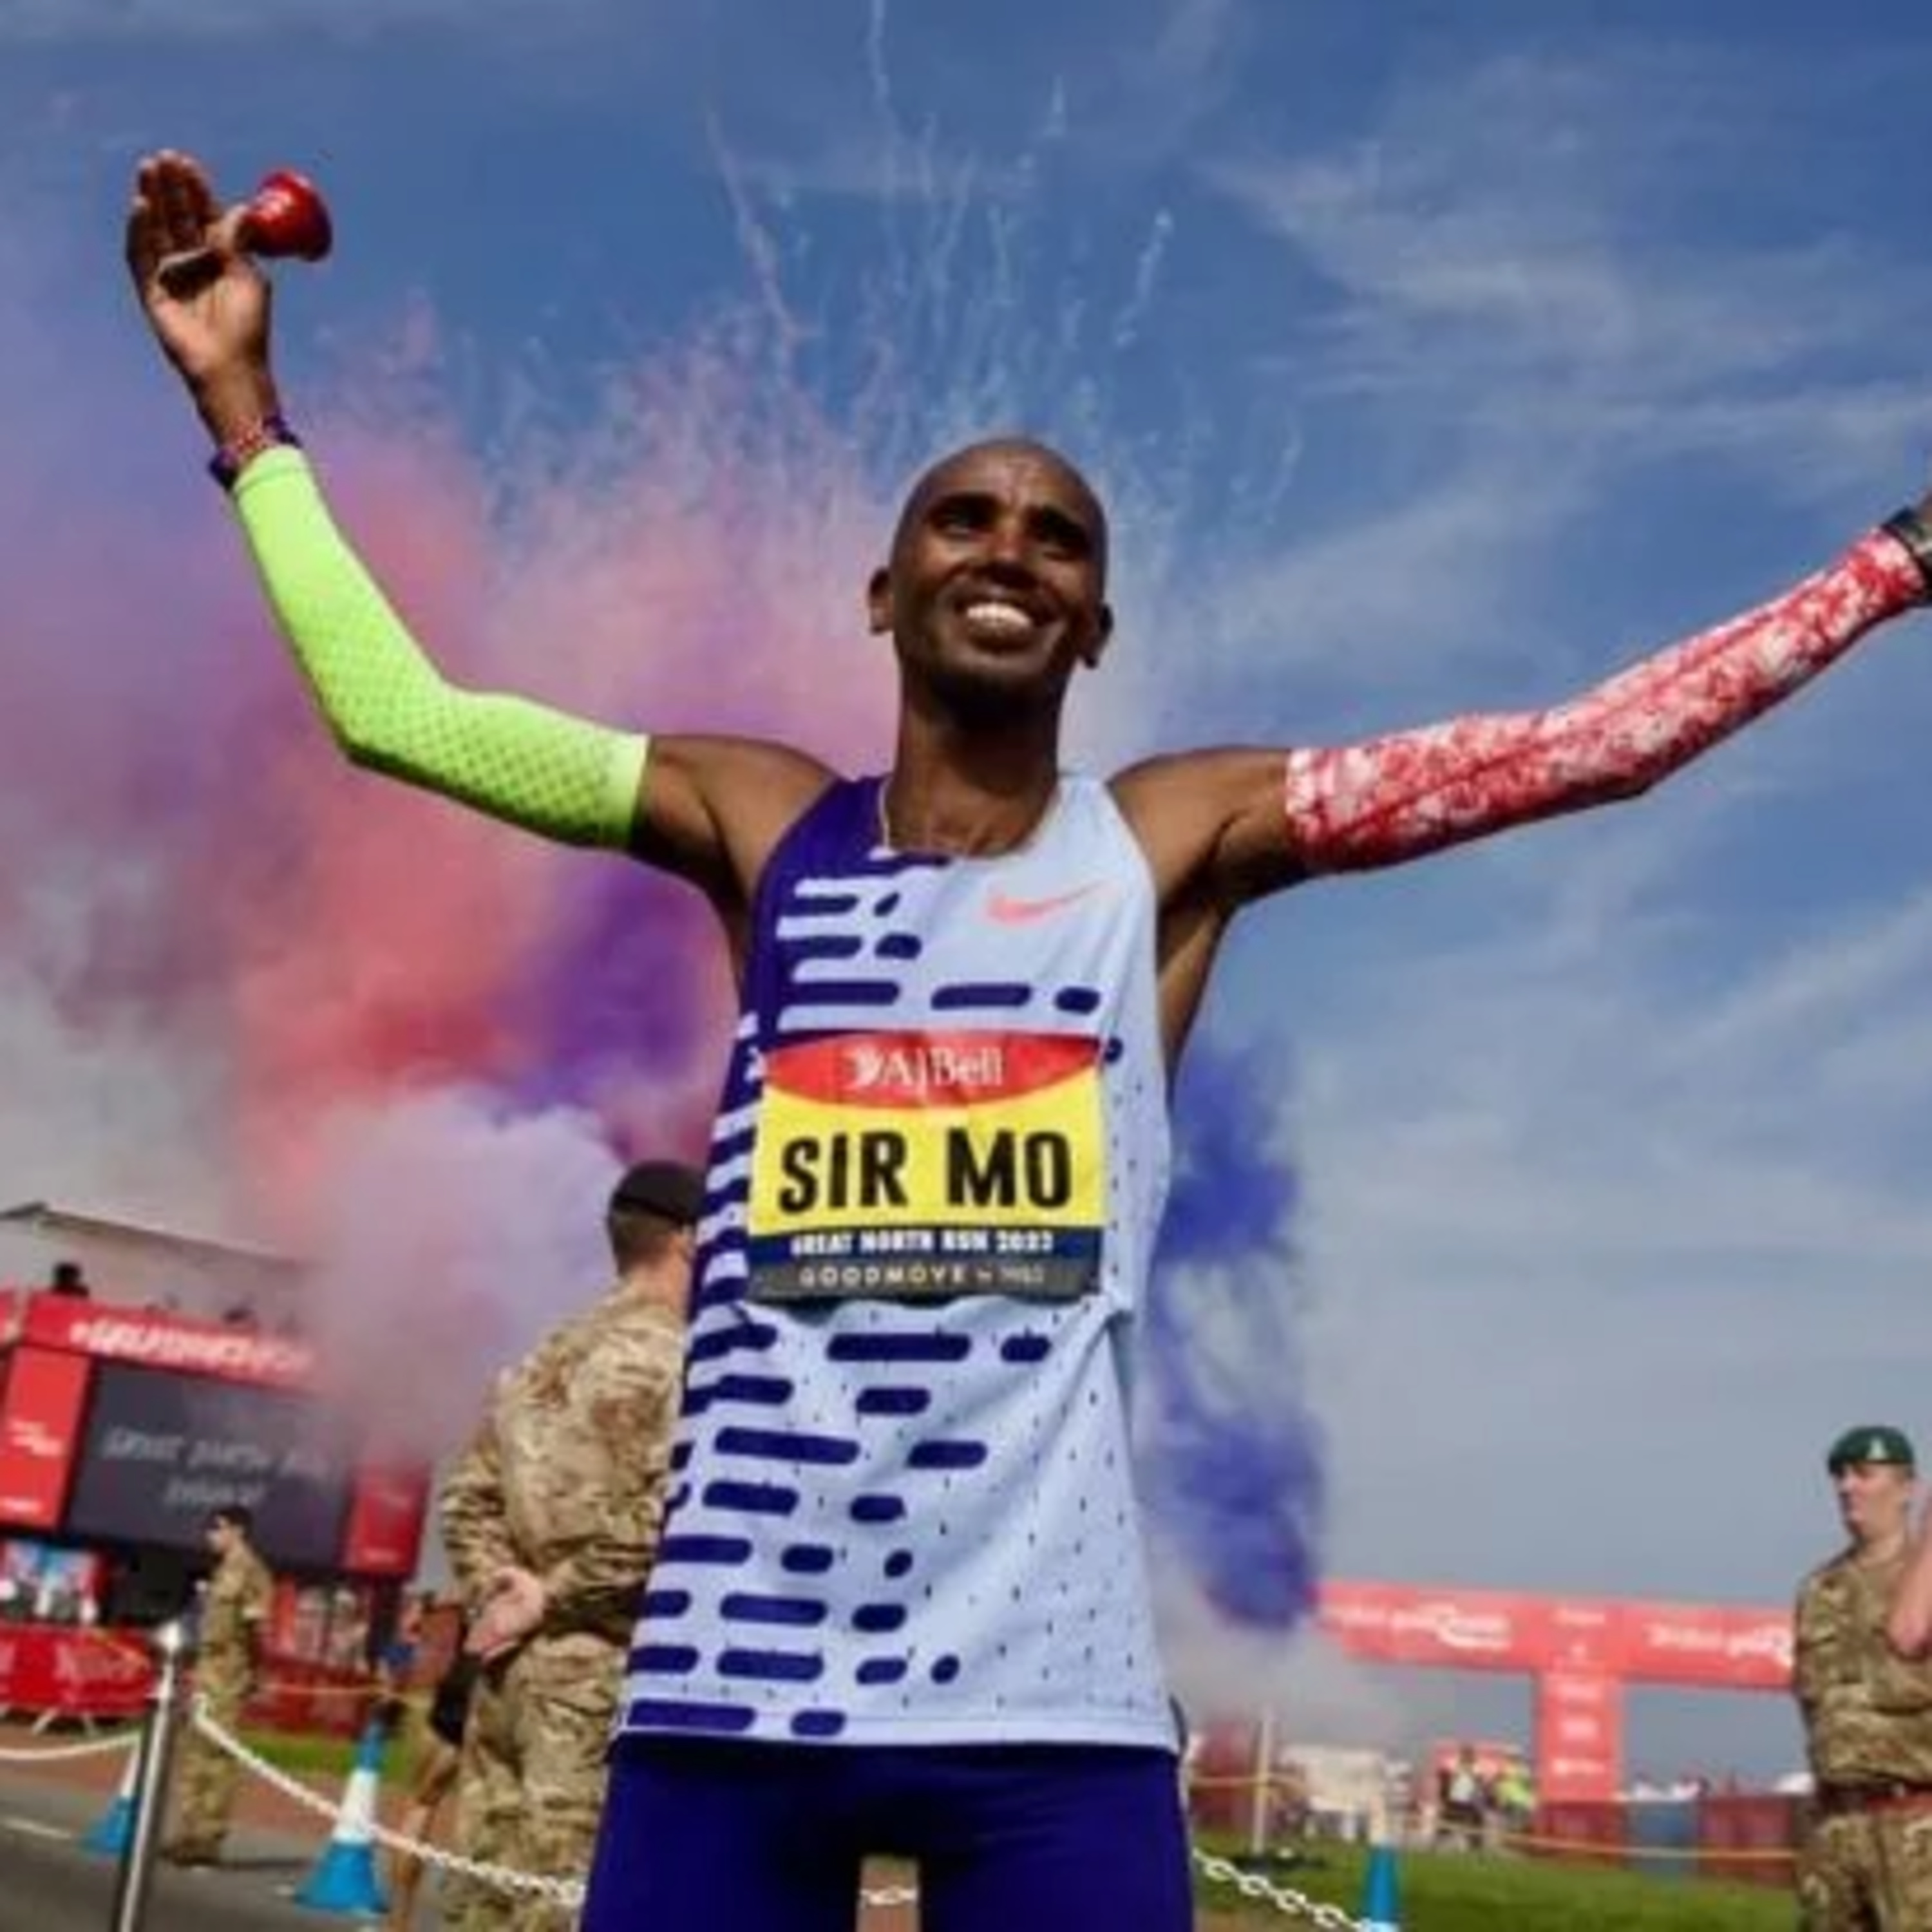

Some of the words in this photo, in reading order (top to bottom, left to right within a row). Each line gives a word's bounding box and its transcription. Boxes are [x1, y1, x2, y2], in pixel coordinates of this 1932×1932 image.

[779, 1130, 909, 1213] SIR
[947, 1127, 1071, 1208] MO
[860, 1229, 934, 1251] NORTH
